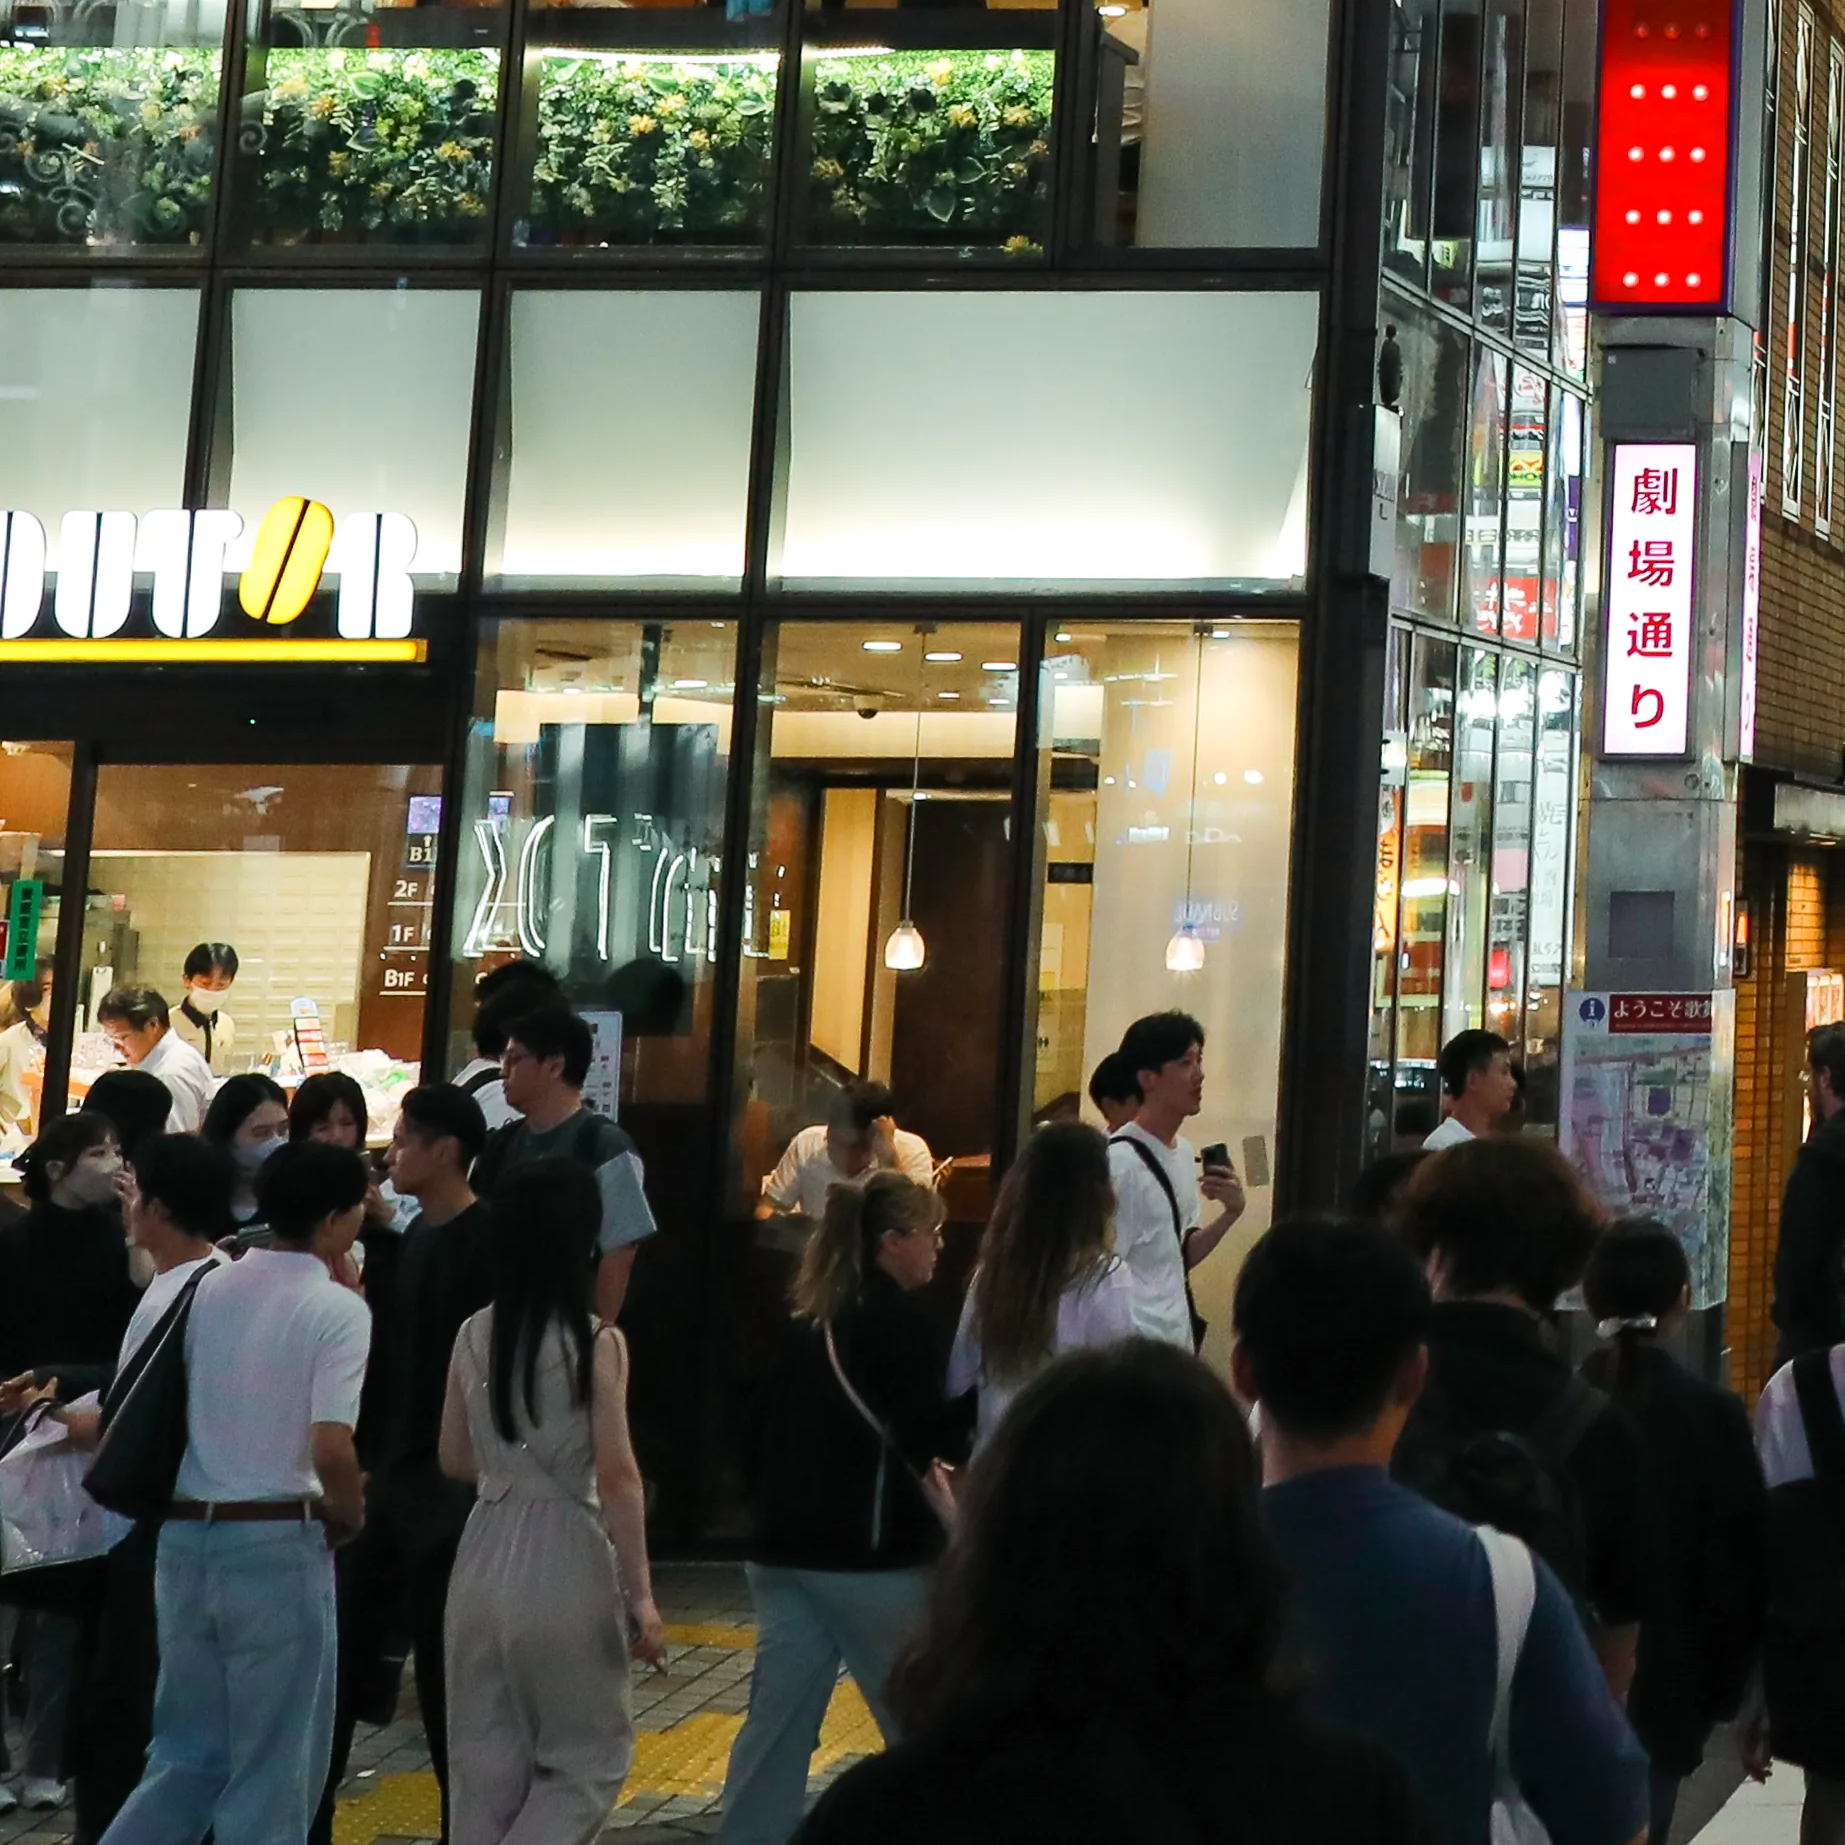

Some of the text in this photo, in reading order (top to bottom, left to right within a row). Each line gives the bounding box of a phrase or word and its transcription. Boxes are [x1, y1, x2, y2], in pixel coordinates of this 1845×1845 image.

[1626, 466, 1680, 729] 劇場通り
[394, 880, 419, 898] 2F
[391, 925, 415, 942] 1F
[384, 969, 415, 987] B1F
